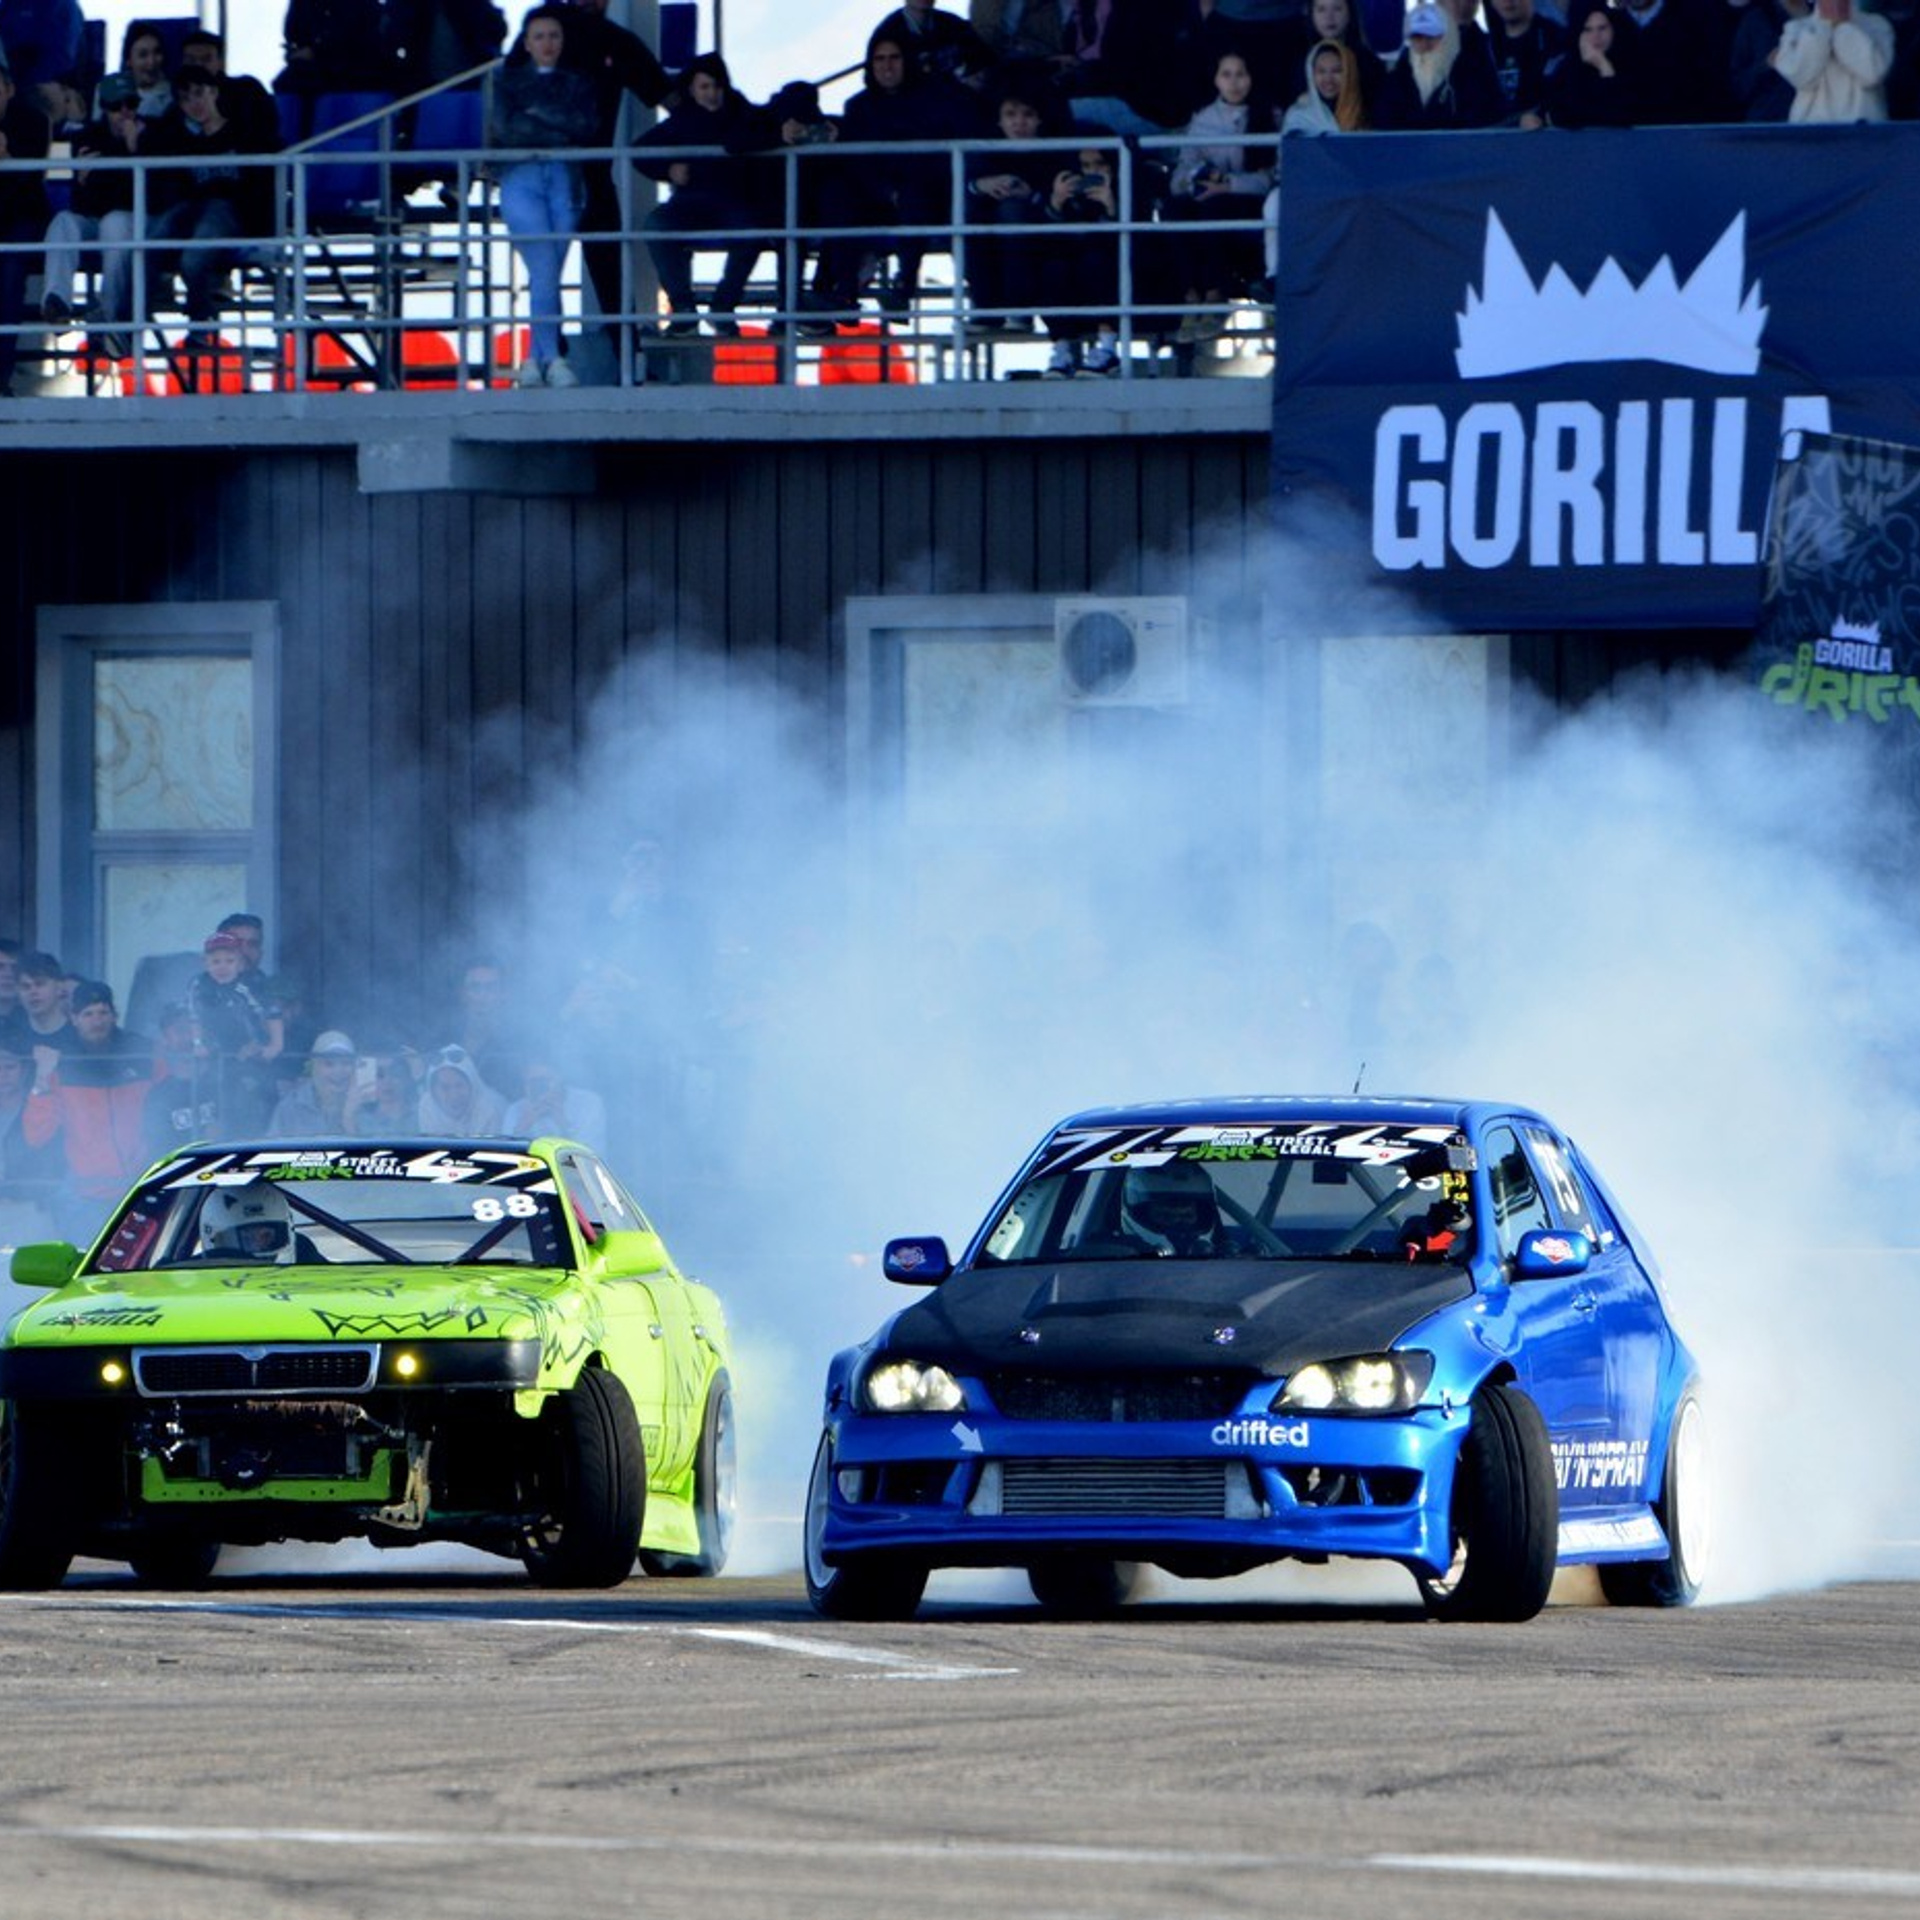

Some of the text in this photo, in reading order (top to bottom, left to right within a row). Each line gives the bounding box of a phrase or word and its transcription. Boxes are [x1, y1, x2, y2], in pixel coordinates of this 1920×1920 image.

[1814, 638, 1893, 672] GORILLA
[1263, 1136, 1327, 1146] STREET
[1280, 1145, 1333, 1155] LEGAL
[339, 1157, 399, 1167] STREET
[354, 1166, 405, 1176] LEGAL
[472, 1194, 539, 1222] 88
[1211, 1420, 1309, 1448] drifted
